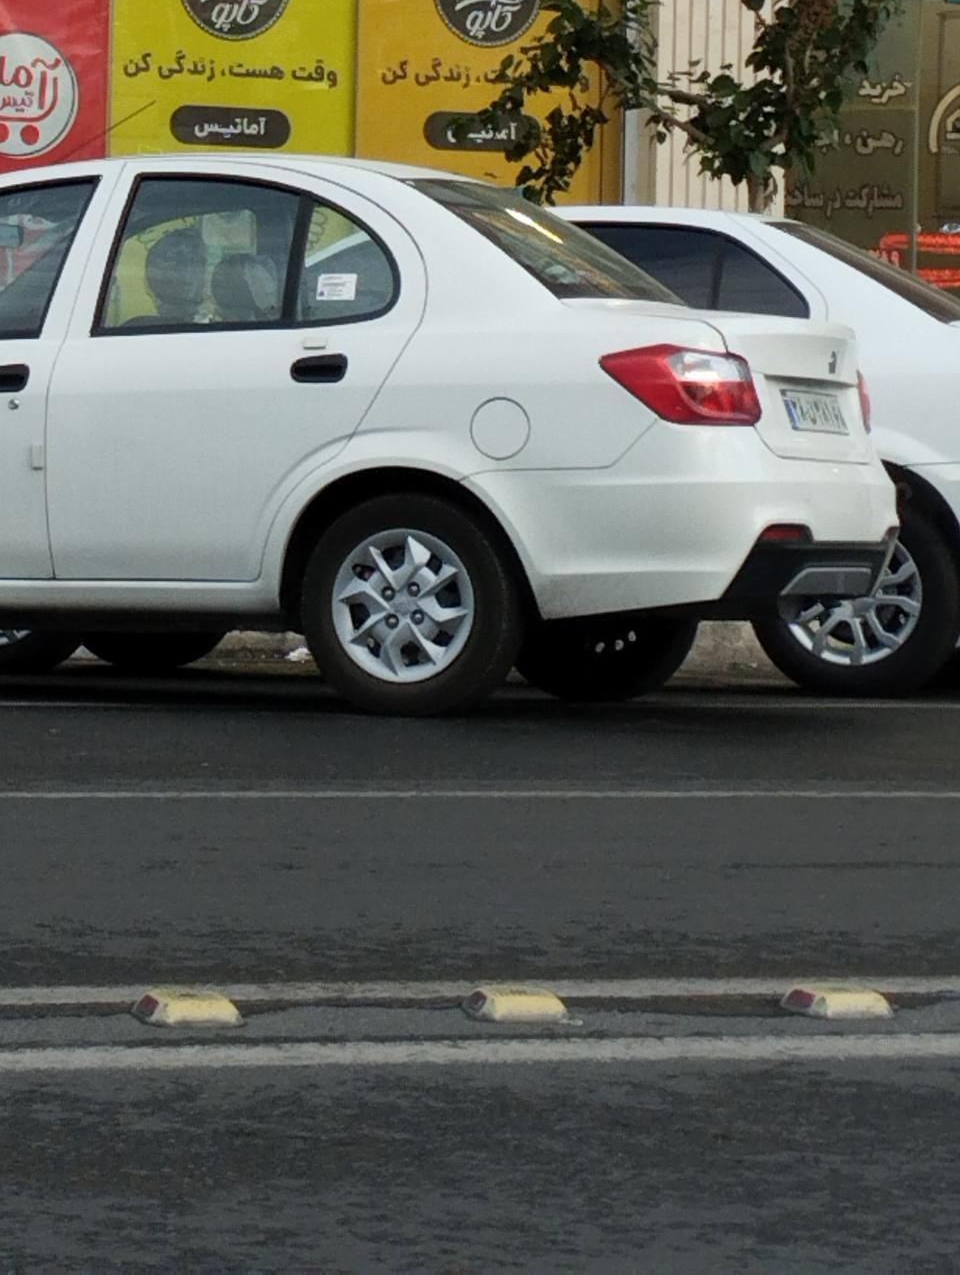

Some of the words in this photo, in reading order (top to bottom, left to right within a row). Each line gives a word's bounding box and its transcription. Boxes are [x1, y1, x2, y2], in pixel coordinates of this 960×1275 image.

[466, 4, 522, 39] کاپو
[123, 52, 152, 78] کن
[157, 50, 216, 82] زندگی
[291, 59, 338, 89] وقت
[381, 58, 409, 85] کن
[414, 57, 471, 89] زندگی
[858, 74, 913, 103] خرید
[194, 116, 266, 138] آماتیس
[845, 185, 903, 219] مشارکت
